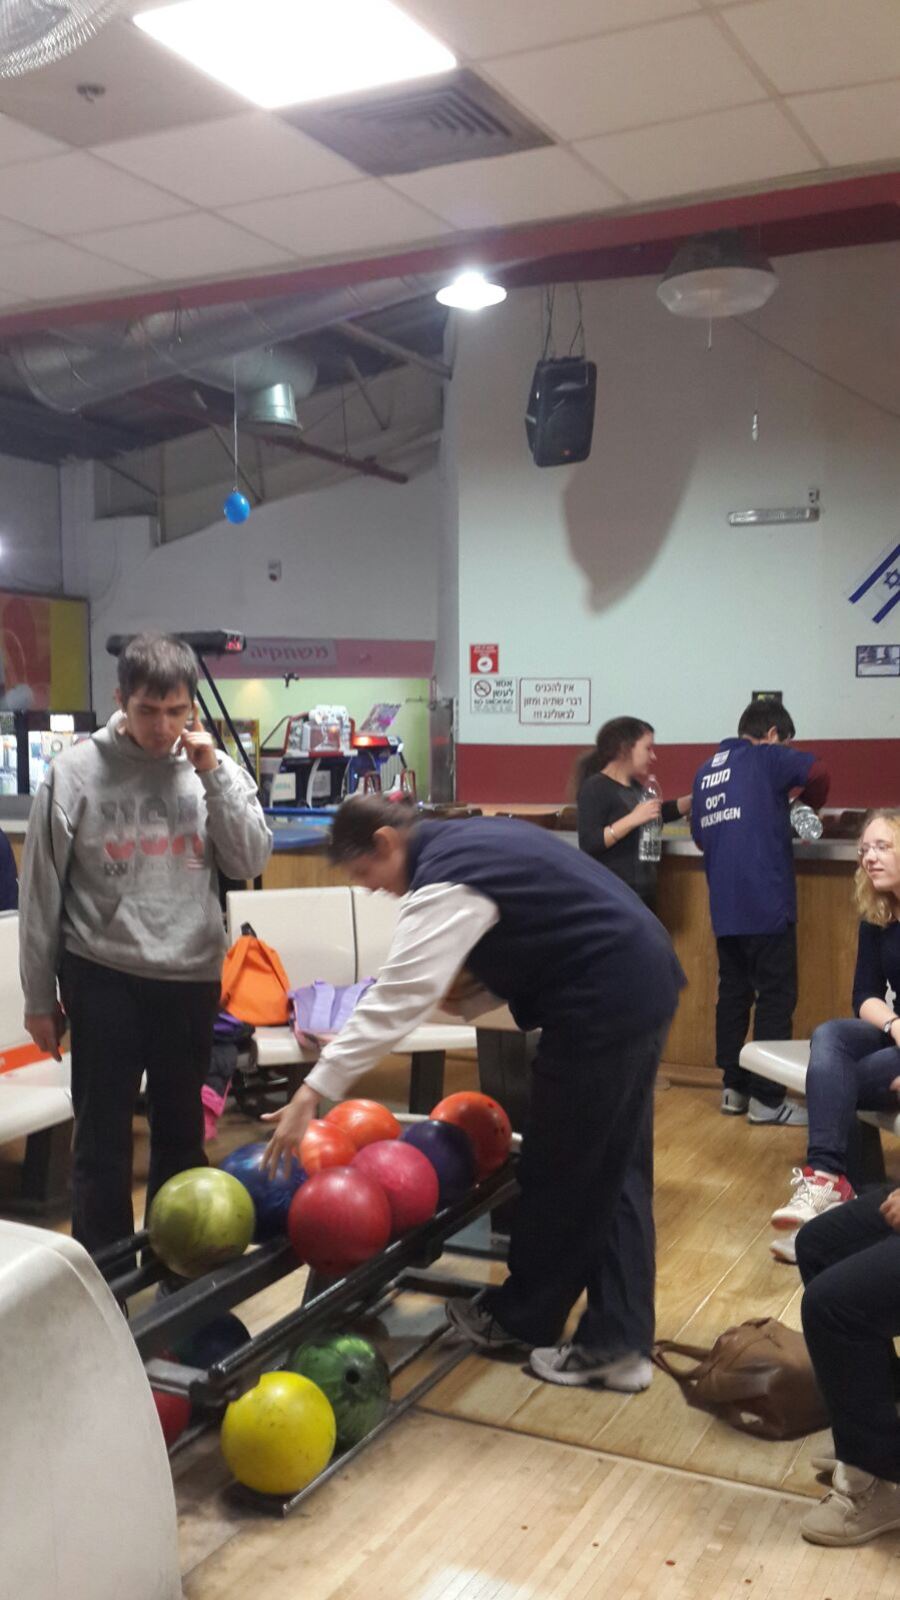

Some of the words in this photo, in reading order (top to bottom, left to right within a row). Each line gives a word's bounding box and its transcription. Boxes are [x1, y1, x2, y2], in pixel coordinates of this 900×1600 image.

[535, 681, 562, 692] להכניס
[563, 683, 575, 694] אין
[523, 696, 541, 708] ומזון
[542, 697, 564, 705] שתיה
[565, 696, 582, 706] דברי
[701, 768, 731, 790] משה
